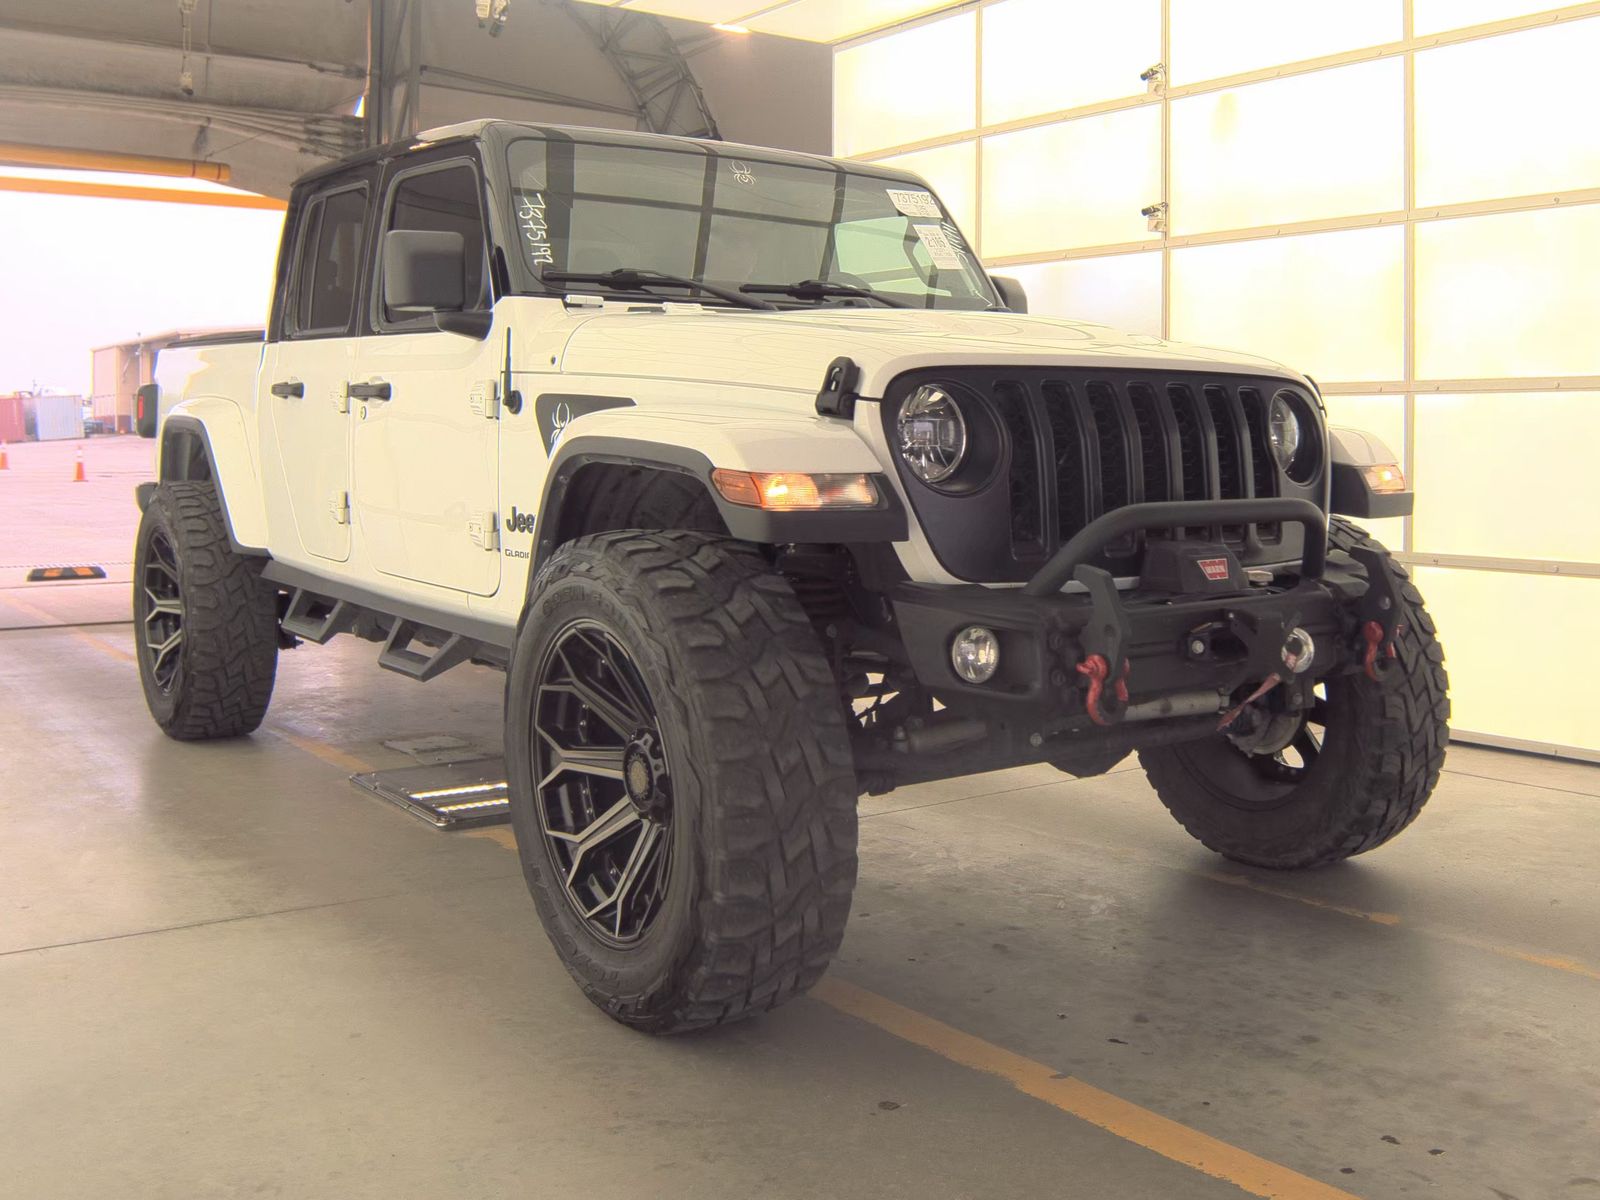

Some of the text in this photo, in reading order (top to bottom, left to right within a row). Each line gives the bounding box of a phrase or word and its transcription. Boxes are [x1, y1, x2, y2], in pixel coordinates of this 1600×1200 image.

[519, 193, 553, 266] 7375192
[506, 506, 536, 534] Jee
[505, 548, 529, 559] GLADI
